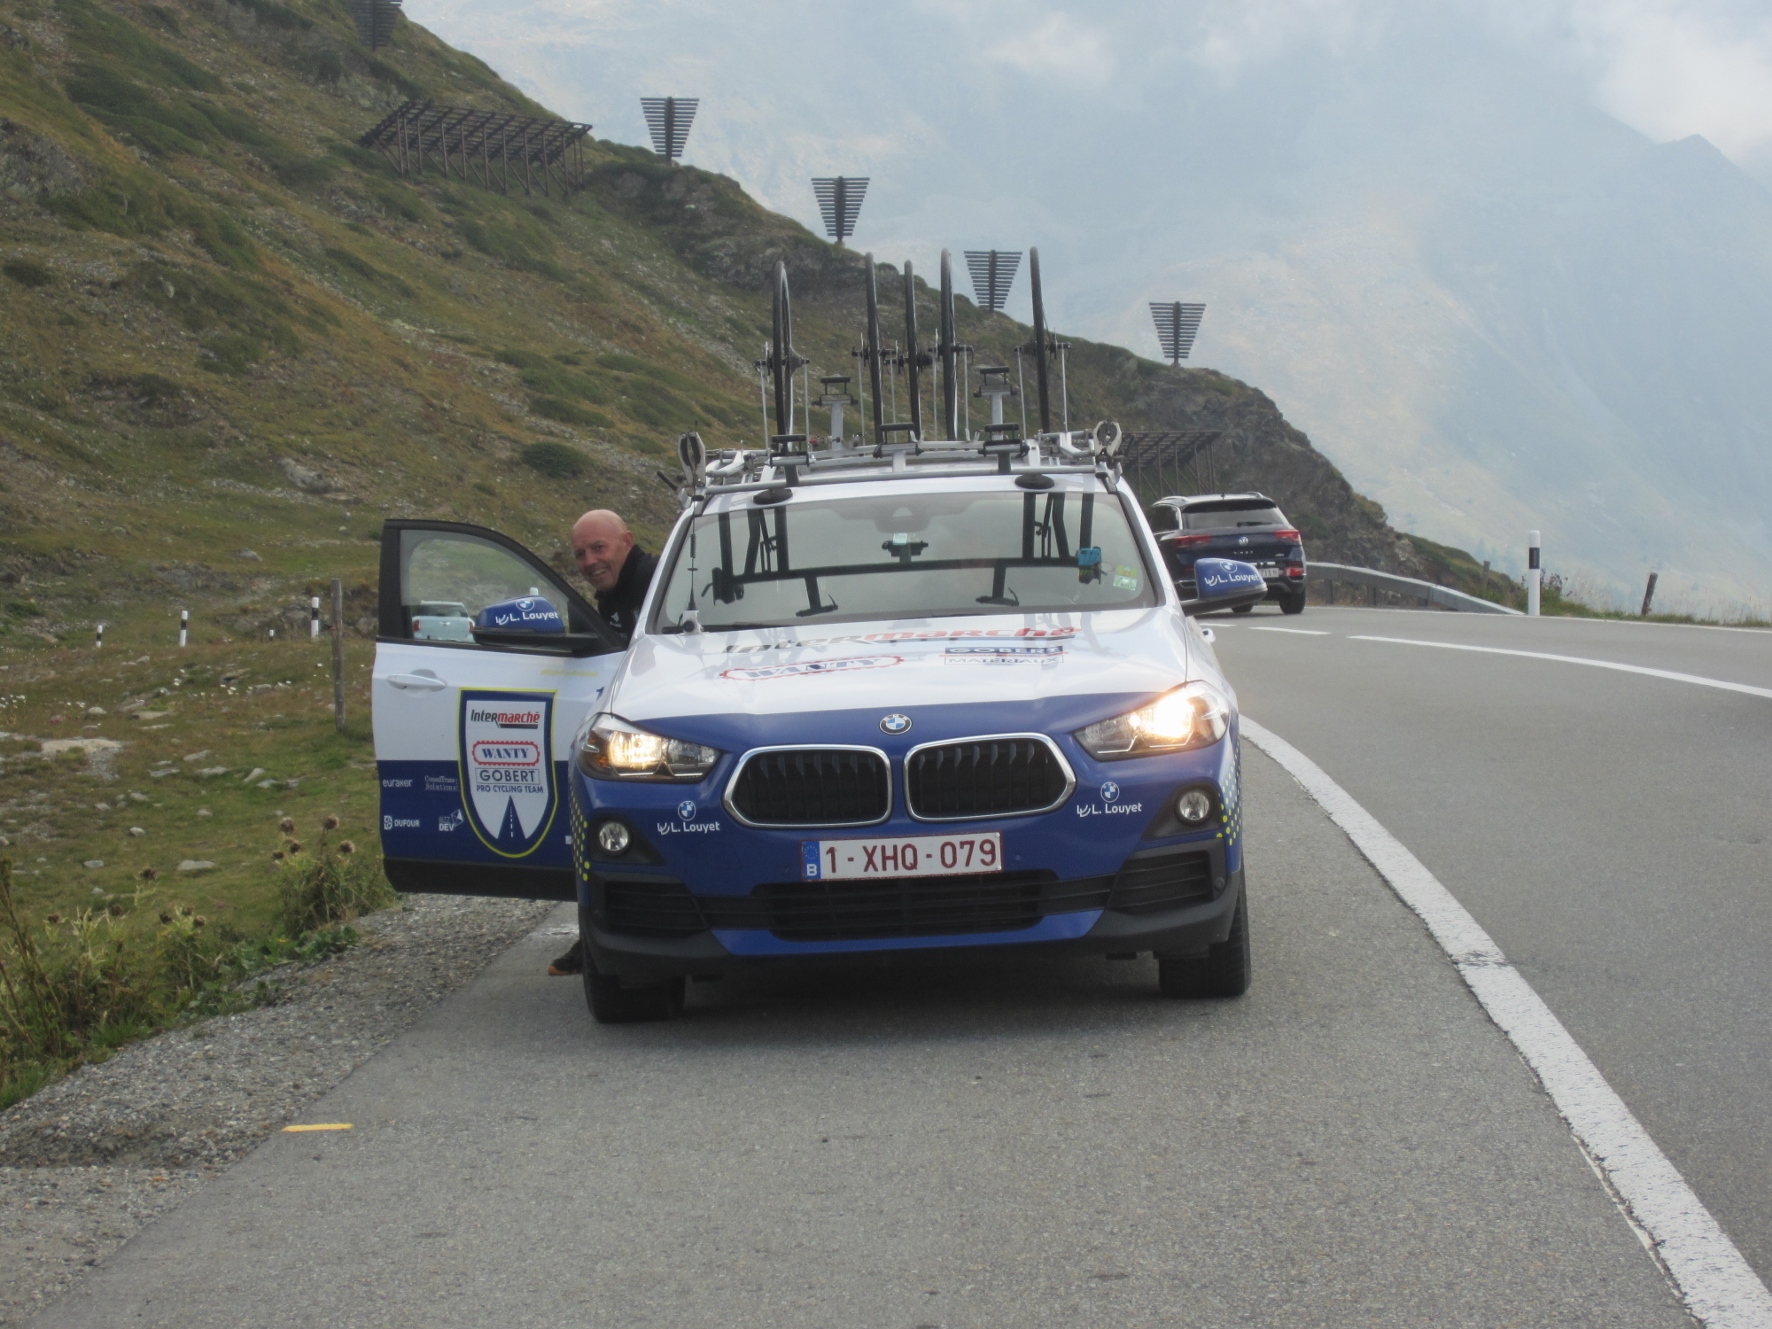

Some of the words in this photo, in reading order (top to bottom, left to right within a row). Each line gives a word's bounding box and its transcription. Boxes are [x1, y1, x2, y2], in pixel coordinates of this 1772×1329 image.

[1229, 573, 1260, 583] Louyet
[522, 611, 559, 621] Louyet
[745, 658, 880, 678] WANTY
[481, 748, 529, 759] WANTY
[479, 769, 535, 783] GOBERT
[476, 784, 491, 793] PRO
[492, 785, 522, 793] CYCLING
[524, 785, 544, 794] TEAM
[1105, 802, 1142, 815] Louyet
[394, 819, 420, 828] DUFOUR
[438, 823, 456, 832] DEV
[682, 821, 720, 834] Louyet
[806, 863, 818, 876] B
